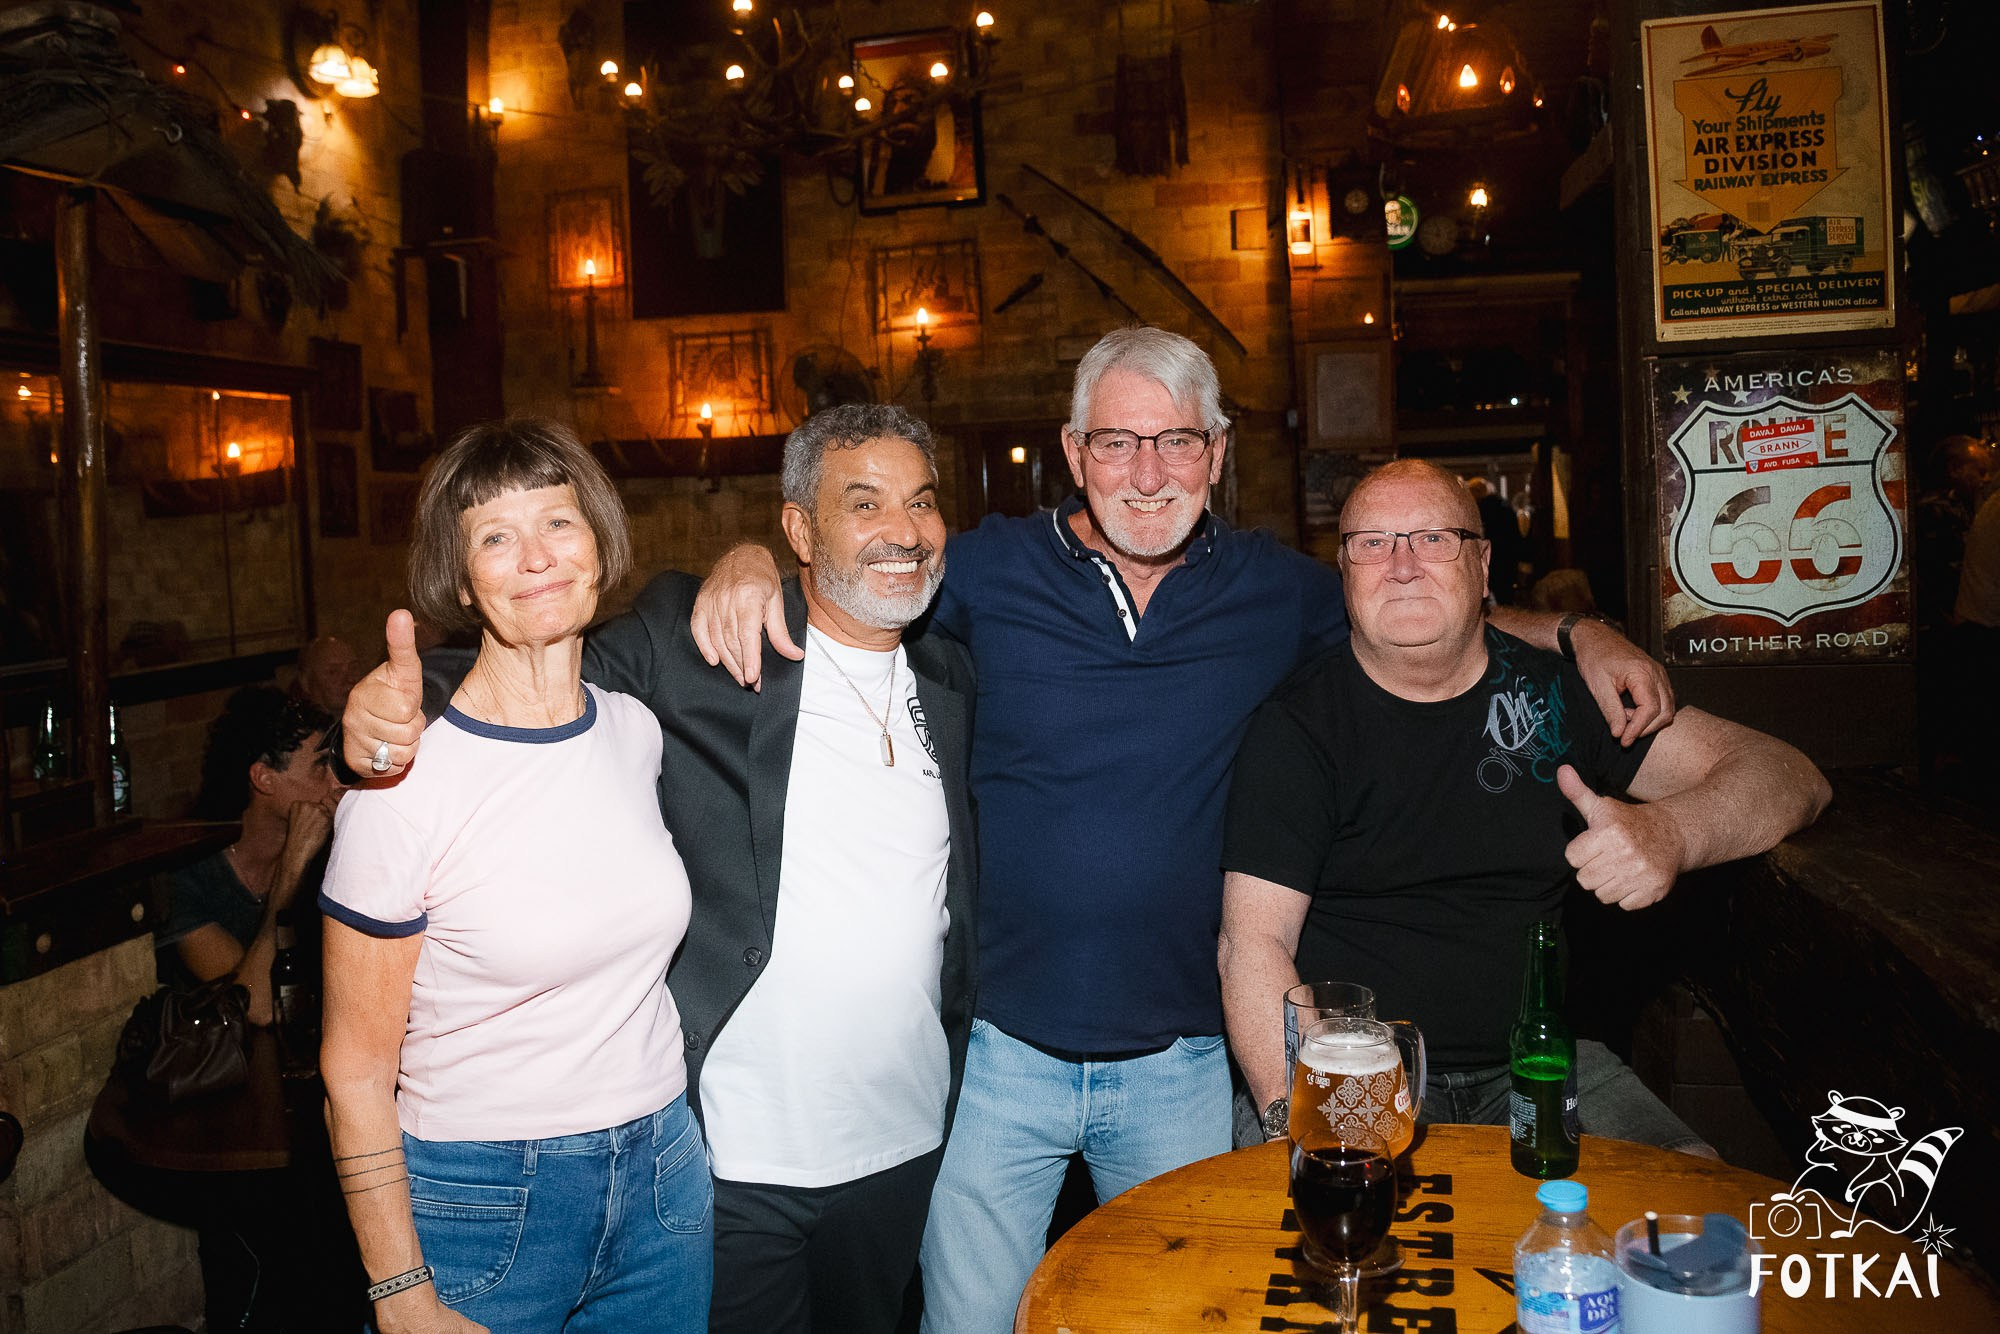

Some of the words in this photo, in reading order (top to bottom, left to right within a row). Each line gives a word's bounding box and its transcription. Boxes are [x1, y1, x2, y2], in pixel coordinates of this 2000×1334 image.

[1724, 77, 1782, 117] Fly
[1692, 119, 1731, 134] Your
[1736, 110, 1825, 132] Shipments
[1693, 136, 1730, 156] AIR
[1735, 128, 1825, 152] EXPRESS
[1704, 150, 1817, 174] DIVISION
[1694, 174, 1756, 192] RAILWAY
[1760, 169, 1828, 187] EXPRESS
[1828, 232, 1854, 240] SERVICE
[1672, 288, 1724, 300] PICK-UP
[1728, 285, 1749, 296] and
[1756, 282, 1813, 294] SPECIAL
[1818, 278, 1881, 290] DELIVERY
[1721, 295, 1758, 305] without
[1762, 294, 1790, 303] extra
[1795, 290, 1819, 300] cost
[1700, 304, 1734, 315] RAILWAY
[1735, 303, 1770, 313] EXPRESS
[1781, 300, 1820, 310] WESTERN
[1822, 298, 1851, 308] UNION
[1853, 297, 1878, 306] office
[1703, 366, 1853, 392] AMERICA'S
[1749, 428, 1775, 438] DAVAJ
[1780, 423, 1805, 434] DAVAJ
[1759, 440, 1800, 453] BRANN
[1782, 457, 1800, 466] FUSA
[1708, 481, 1862, 595] 66
[1688, 635, 1802, 654] MOTHER
[1816, 631, 1889, 649] ROAD
